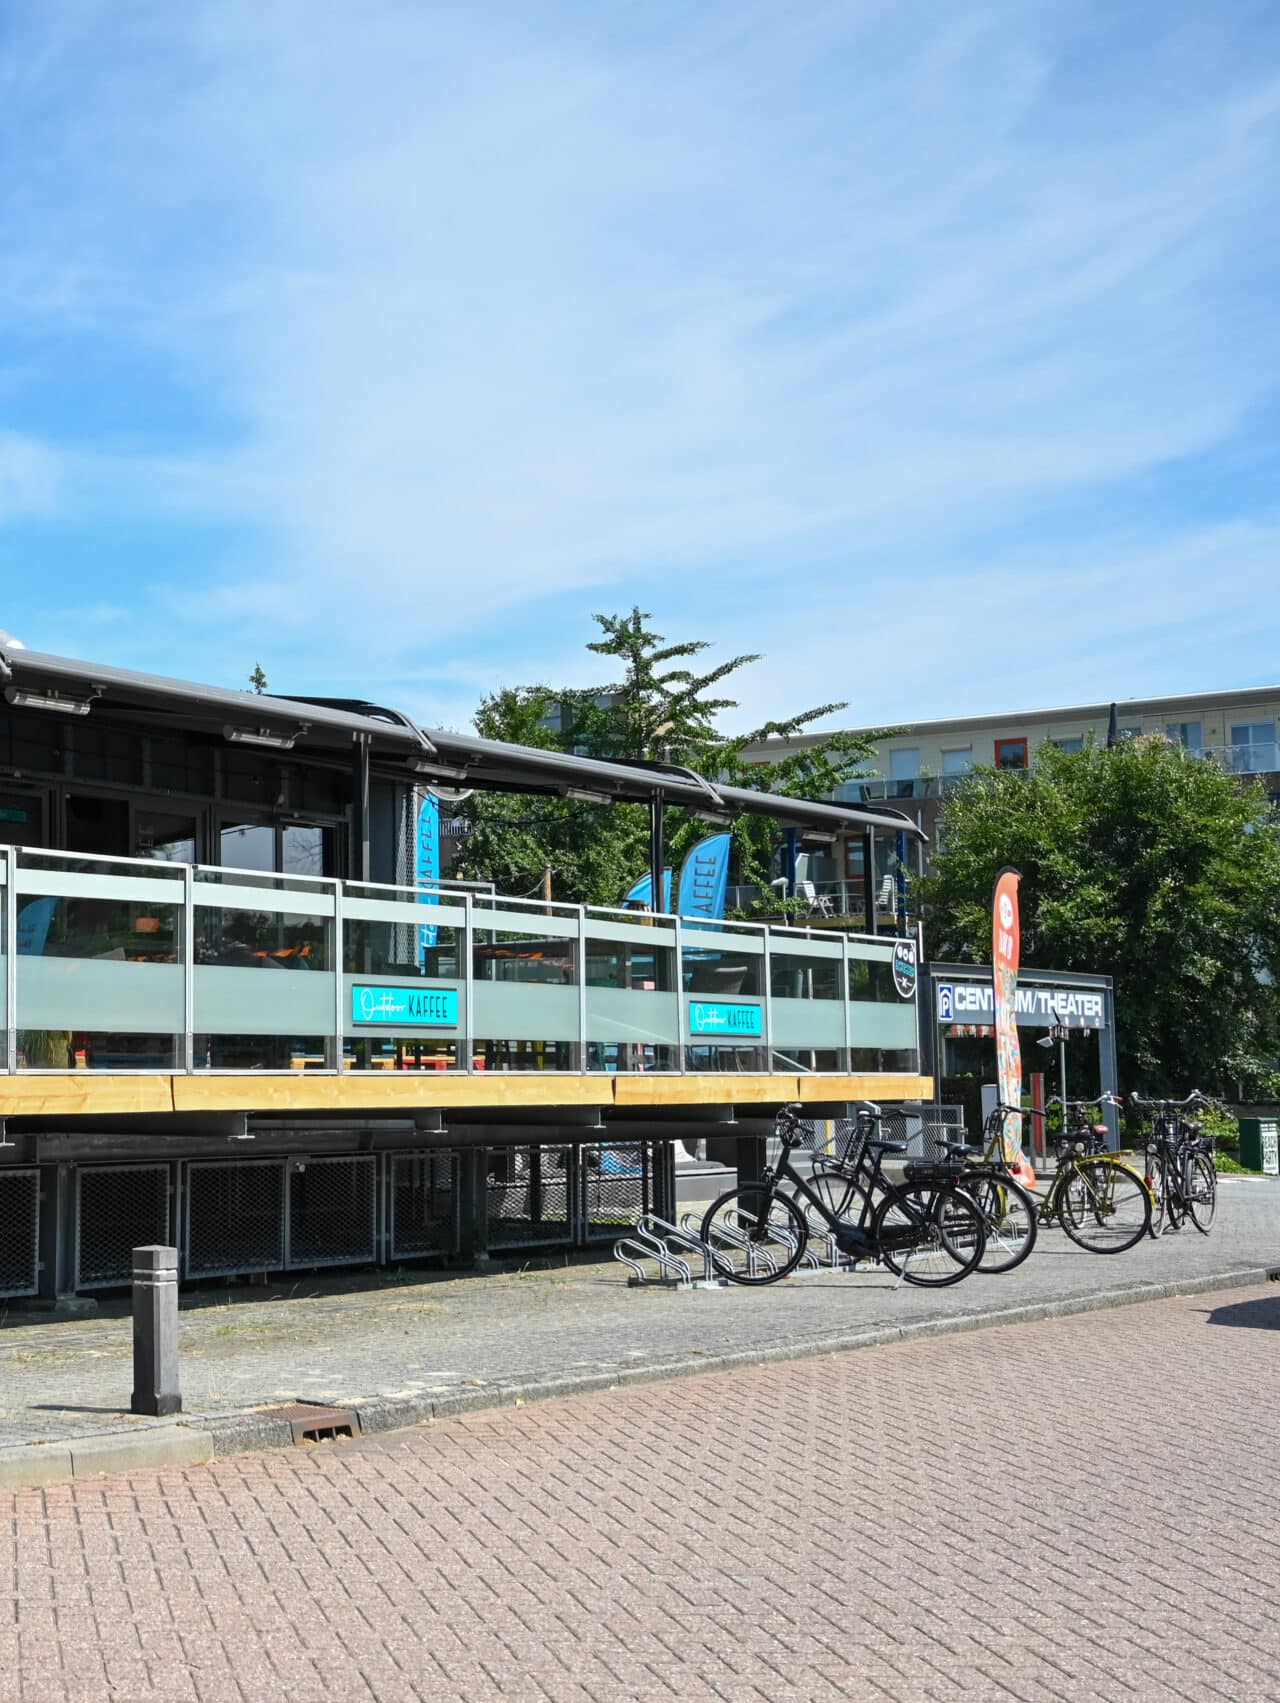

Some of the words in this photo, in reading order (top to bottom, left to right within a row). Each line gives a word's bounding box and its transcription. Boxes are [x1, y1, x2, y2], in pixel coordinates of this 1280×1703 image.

[693, 855, 717, 917] AFFEE
[361, 988, 406, 1021] Outdoor
[408, 994, 448, 1019] KAFFEE
[954, 986, 1102, 1017] CENTM/THEATER
[727, 1009, 756, 1029] KAFFEE
